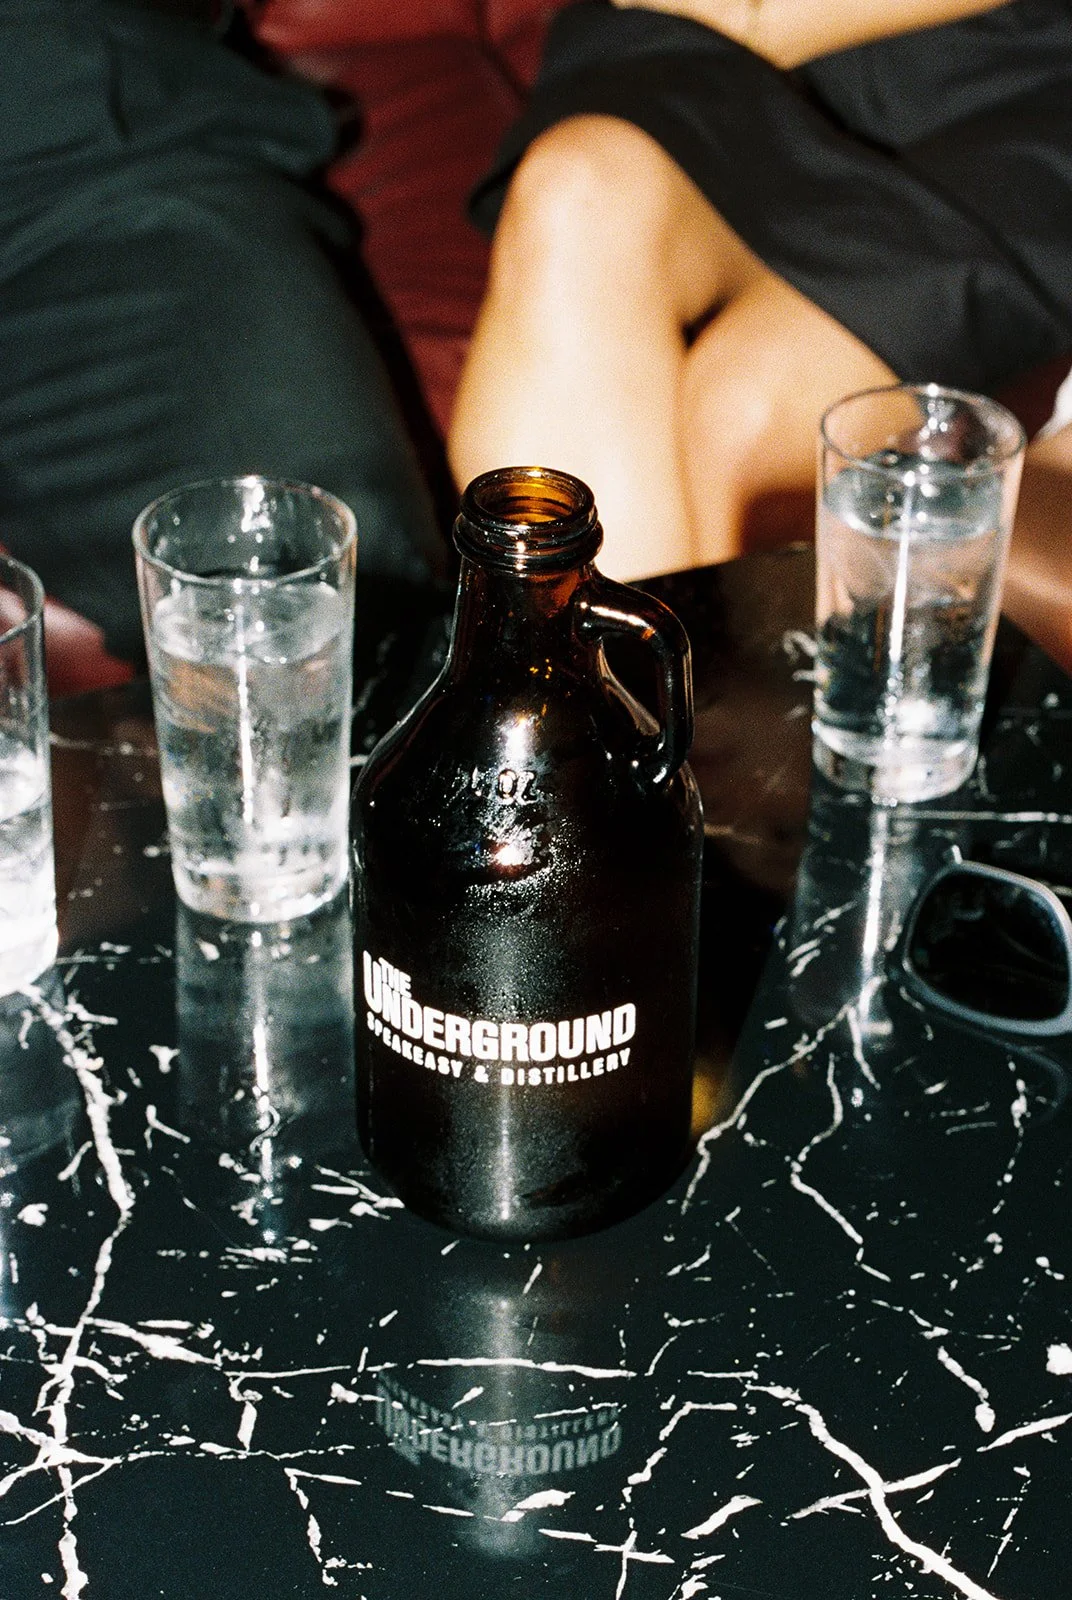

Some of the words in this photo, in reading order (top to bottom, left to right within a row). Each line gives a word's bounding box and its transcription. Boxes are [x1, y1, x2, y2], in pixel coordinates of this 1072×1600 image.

[363, 950, 636, 1062] UNDERGROUND
[378, 957, 412, 999] THE
[367, 1011, 463, 1078] SPEAKEASY
[474, 1064, 489, 1083] &
[501, 1048, 631, 1086] DISTILLERY
